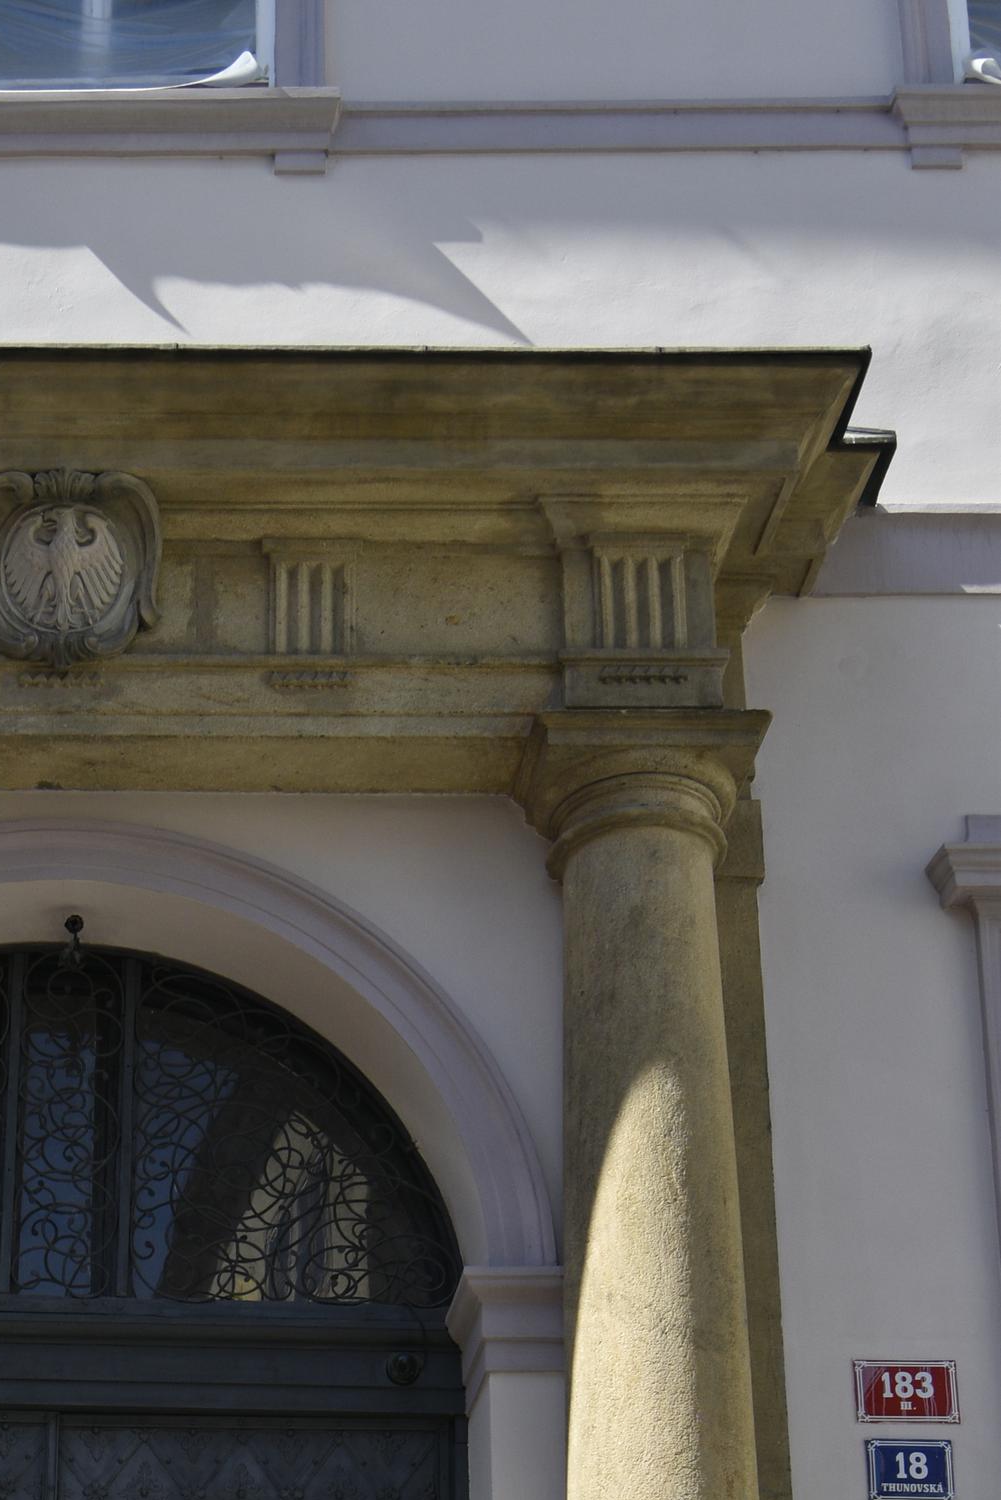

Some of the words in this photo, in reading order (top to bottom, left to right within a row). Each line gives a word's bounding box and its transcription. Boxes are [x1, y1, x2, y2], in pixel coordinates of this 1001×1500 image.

[881, 1371, 934, 1399] 183
[895, 1451, 928, 1479] 18
[881, 1482, 944, 1493] THUNOVSKÁ
